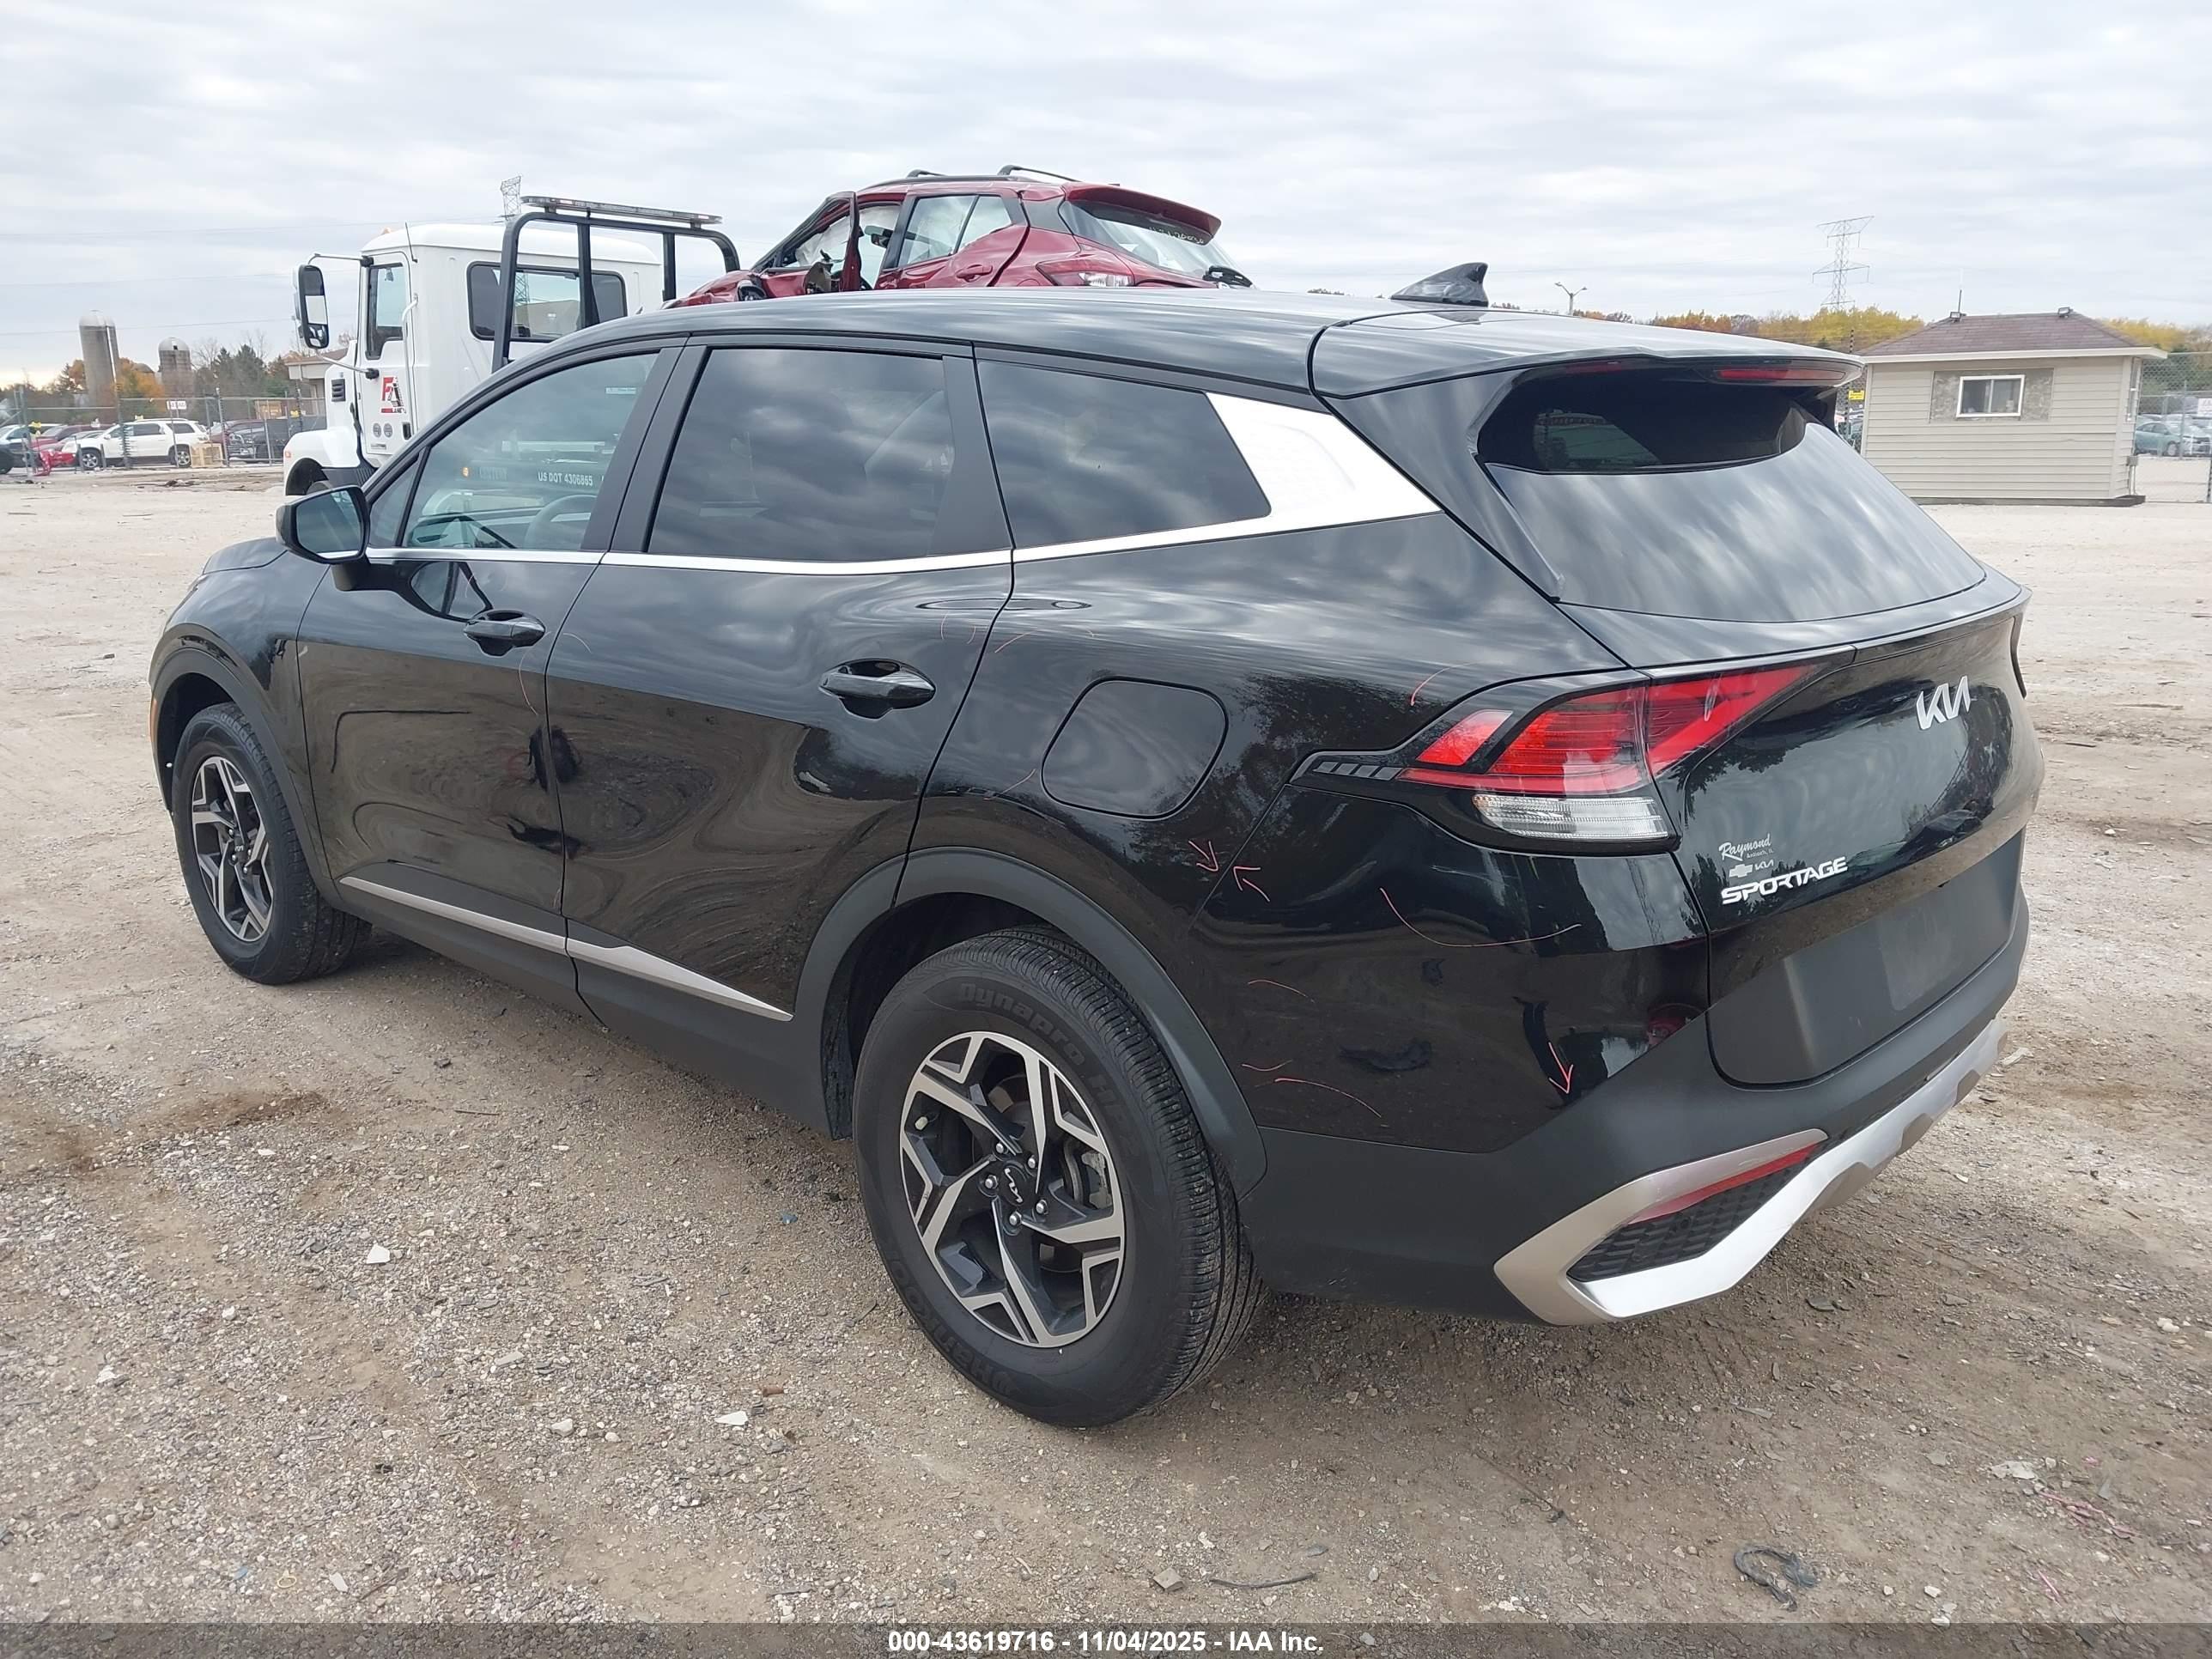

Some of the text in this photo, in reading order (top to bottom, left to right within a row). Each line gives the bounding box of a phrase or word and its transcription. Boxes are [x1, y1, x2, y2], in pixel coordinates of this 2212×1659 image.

[538, 471, 548, 482] US
[549, 472, 562, 483] DOT
[1718, 833, 1772, 861] Raymond
[1720, 856, 1849, 905] SPORTAGE
[960, 982, 1086, 1066] Dynapro
